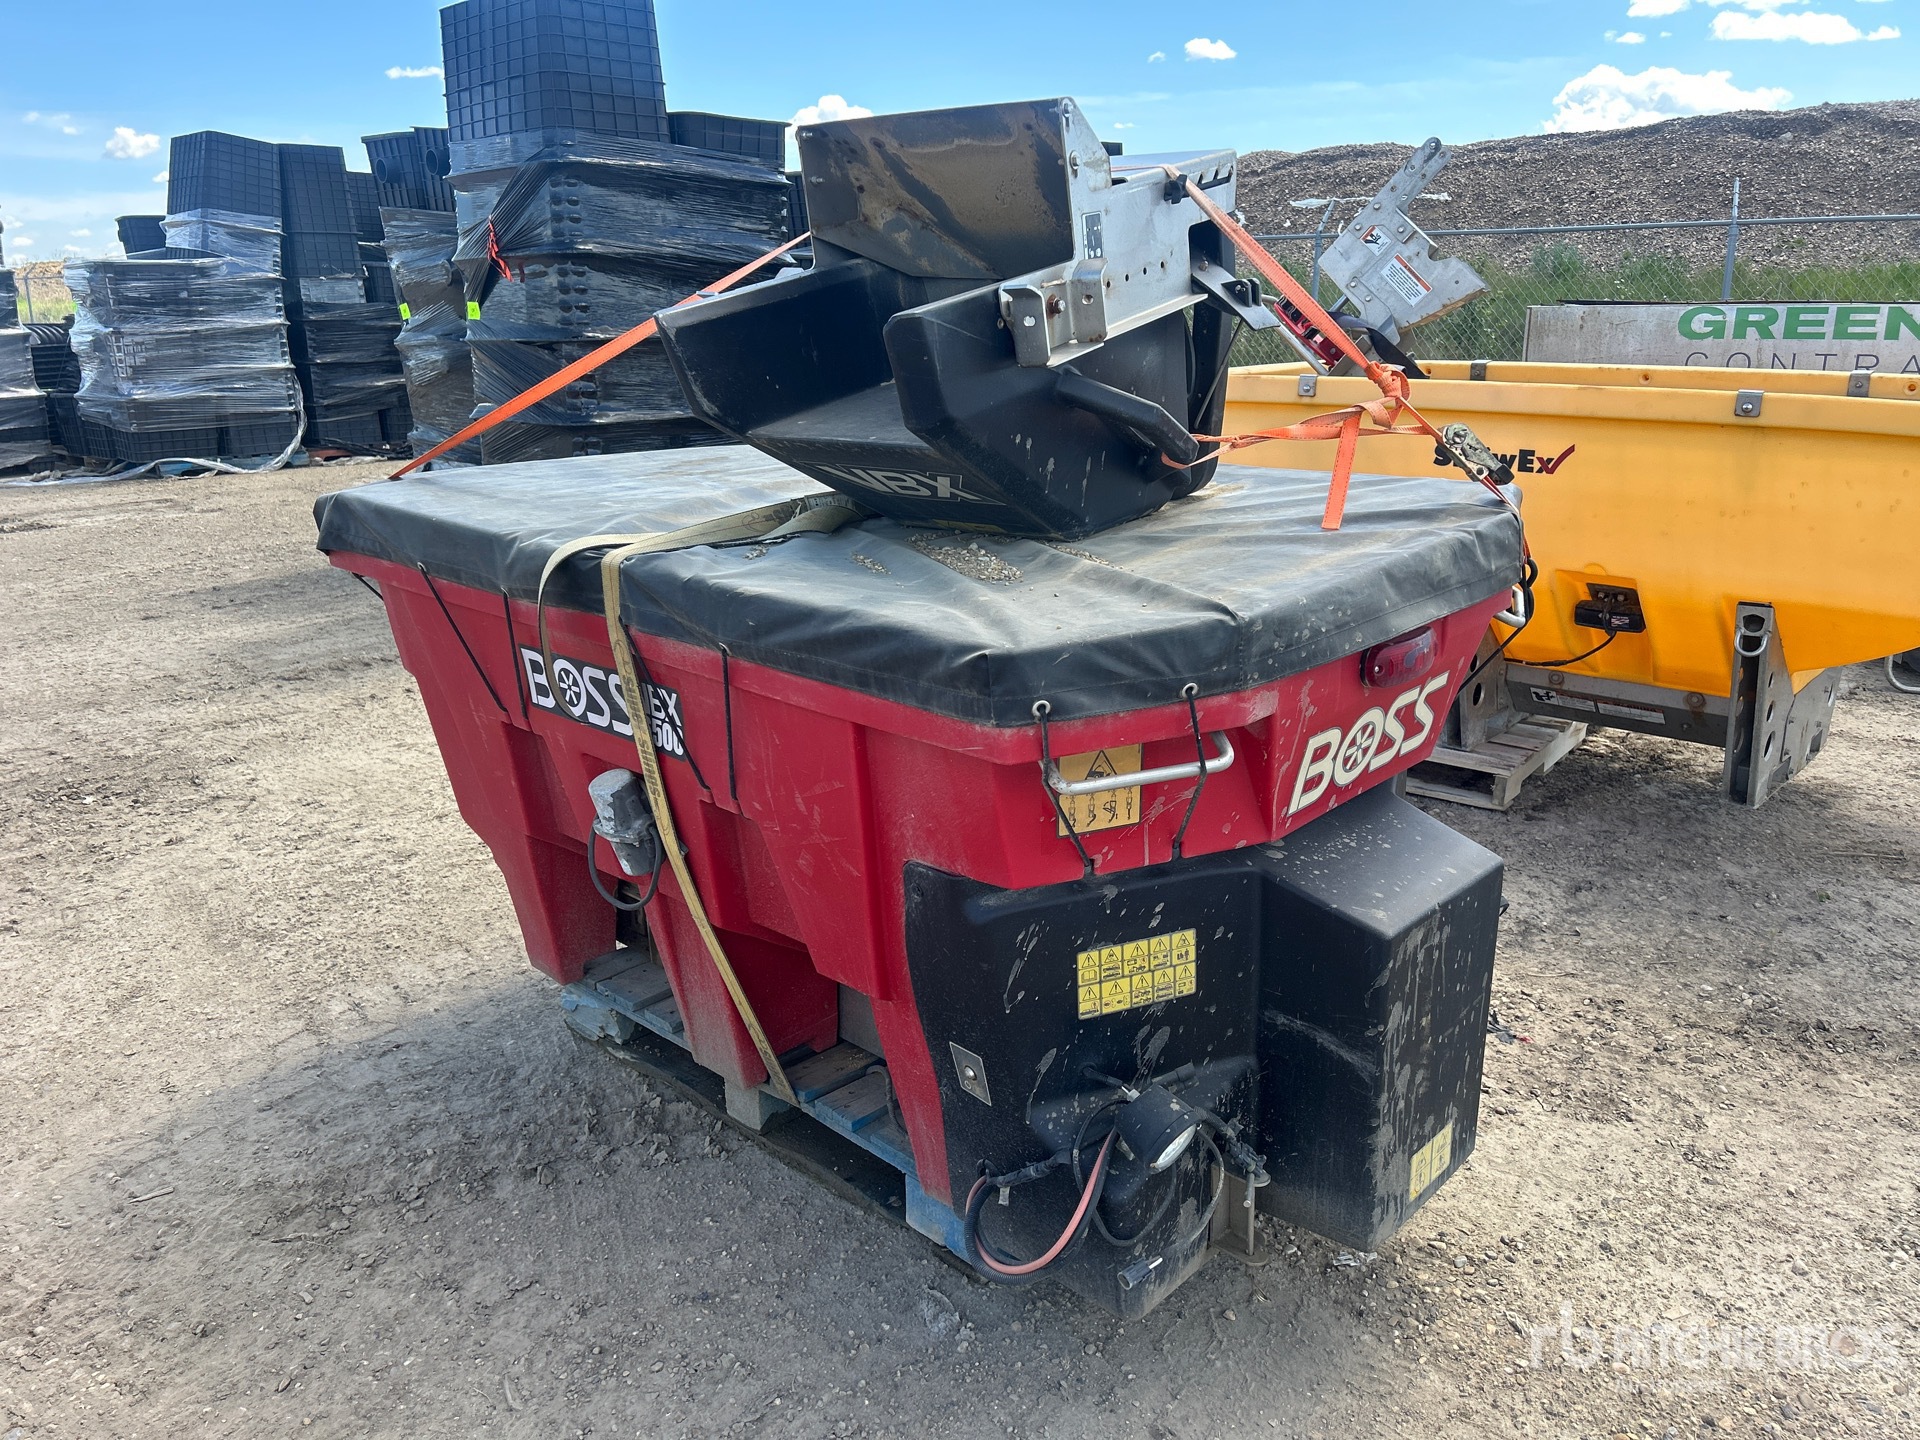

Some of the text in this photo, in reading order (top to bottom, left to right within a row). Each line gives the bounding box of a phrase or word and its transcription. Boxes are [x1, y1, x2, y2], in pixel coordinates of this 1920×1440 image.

[1677, 305, 1920, 341] GREEN
[815, 465, 984, 502] VBX
[521, 647, 635, 736] BOSS
[1286, 670, 1451, 817] BOSS
